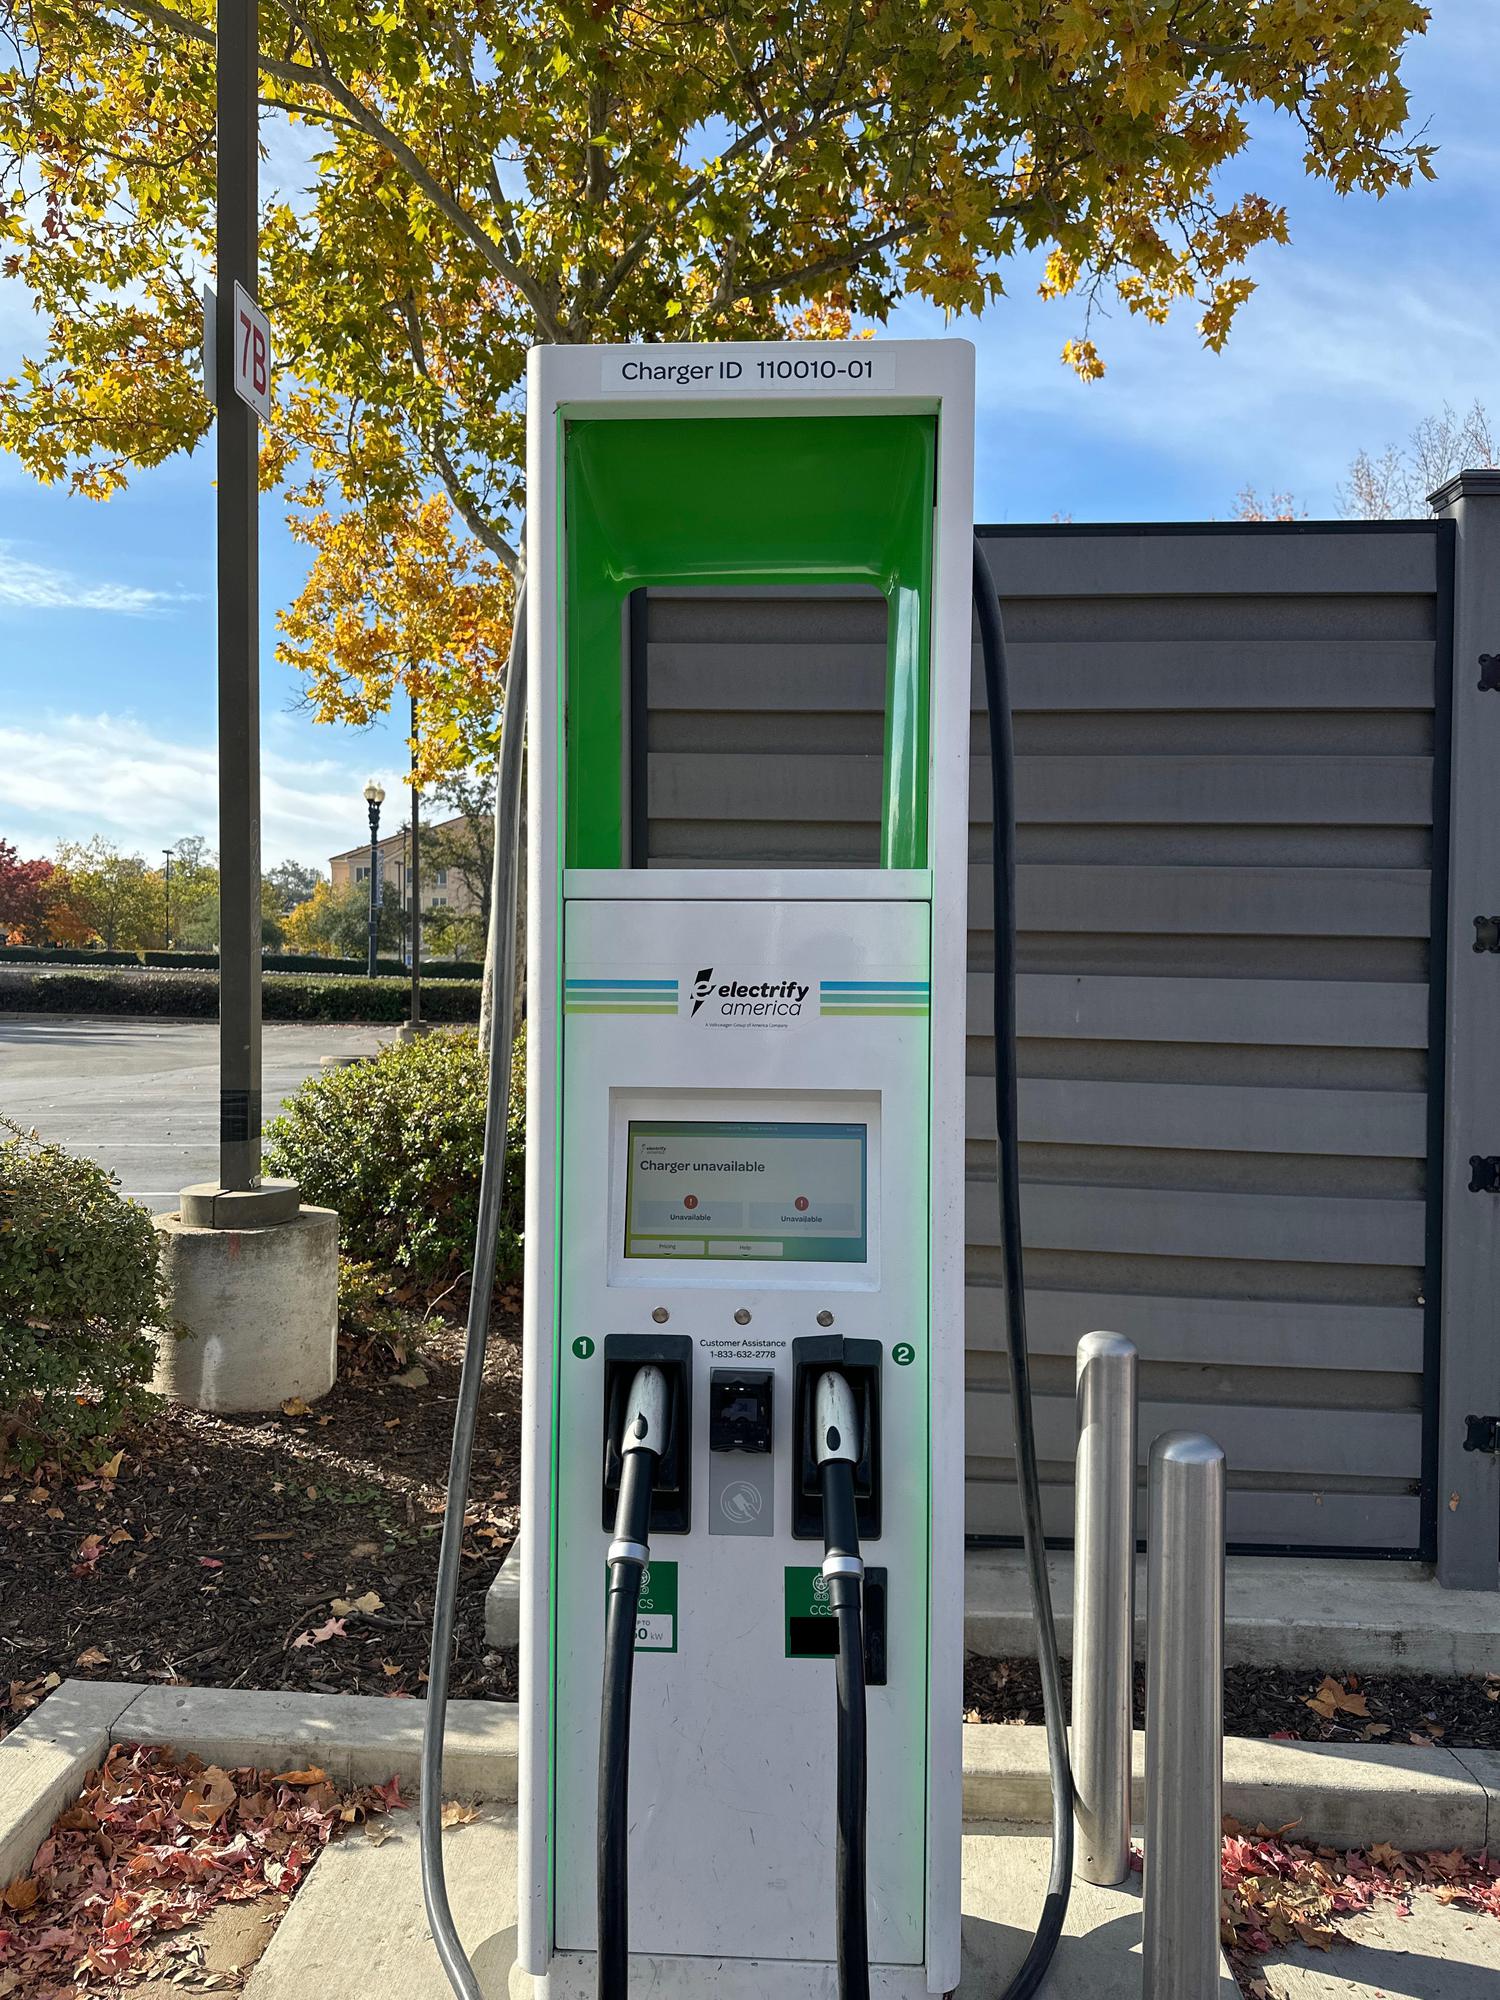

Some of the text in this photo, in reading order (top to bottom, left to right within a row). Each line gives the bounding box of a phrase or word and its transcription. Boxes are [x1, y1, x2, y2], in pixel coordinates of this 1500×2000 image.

[240, 309, 267, 396] 7B
[621, 360, 873, 385] Charger ID 110010-01
[718, 981, 810, 1002] electrify
[720, 1000, 802, 1016] america
[640, 1160, 766, 1174] Charger unavailable
[578, 1342, 587, 1355] 1
[700, 1339, 787, 1347] Customer Assistance
[710, 1350, 776, 1358] 1-833-632-2778
[897, 1347, 910, 1362] 2
[637, 1599, 654, 1609] CS
[650, 1632, 663, 1640] kW
